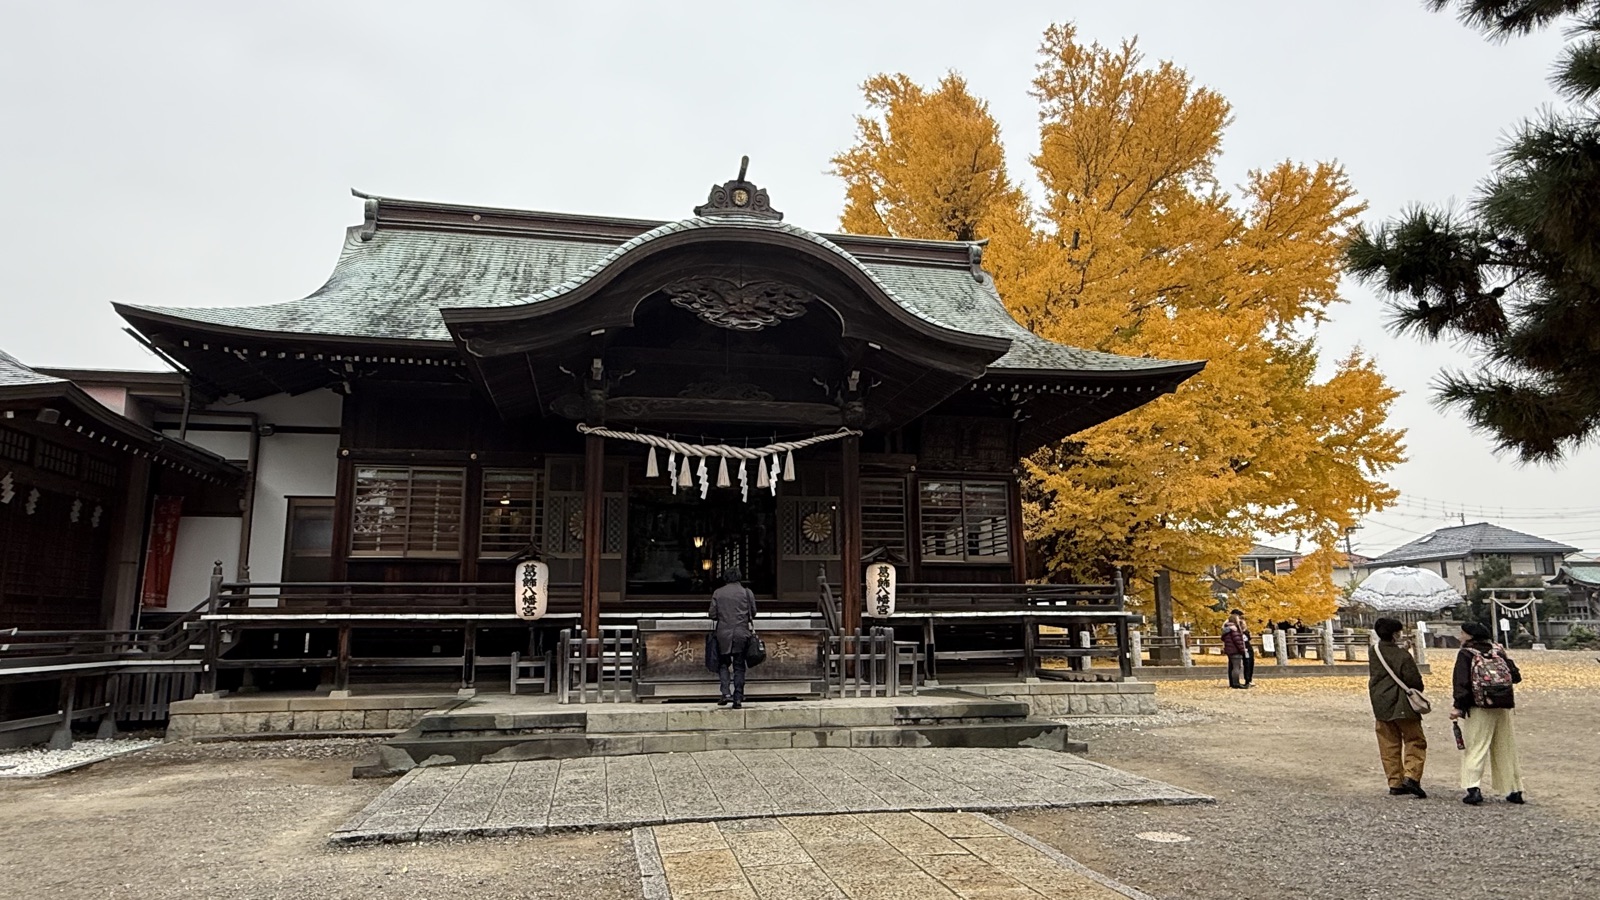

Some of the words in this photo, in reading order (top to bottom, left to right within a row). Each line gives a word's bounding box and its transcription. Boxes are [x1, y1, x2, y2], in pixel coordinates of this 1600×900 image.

[522, 563, 537, 616] 葛飾八幡宮
[876, 565, 891, 615] 葛飾八幡宮
